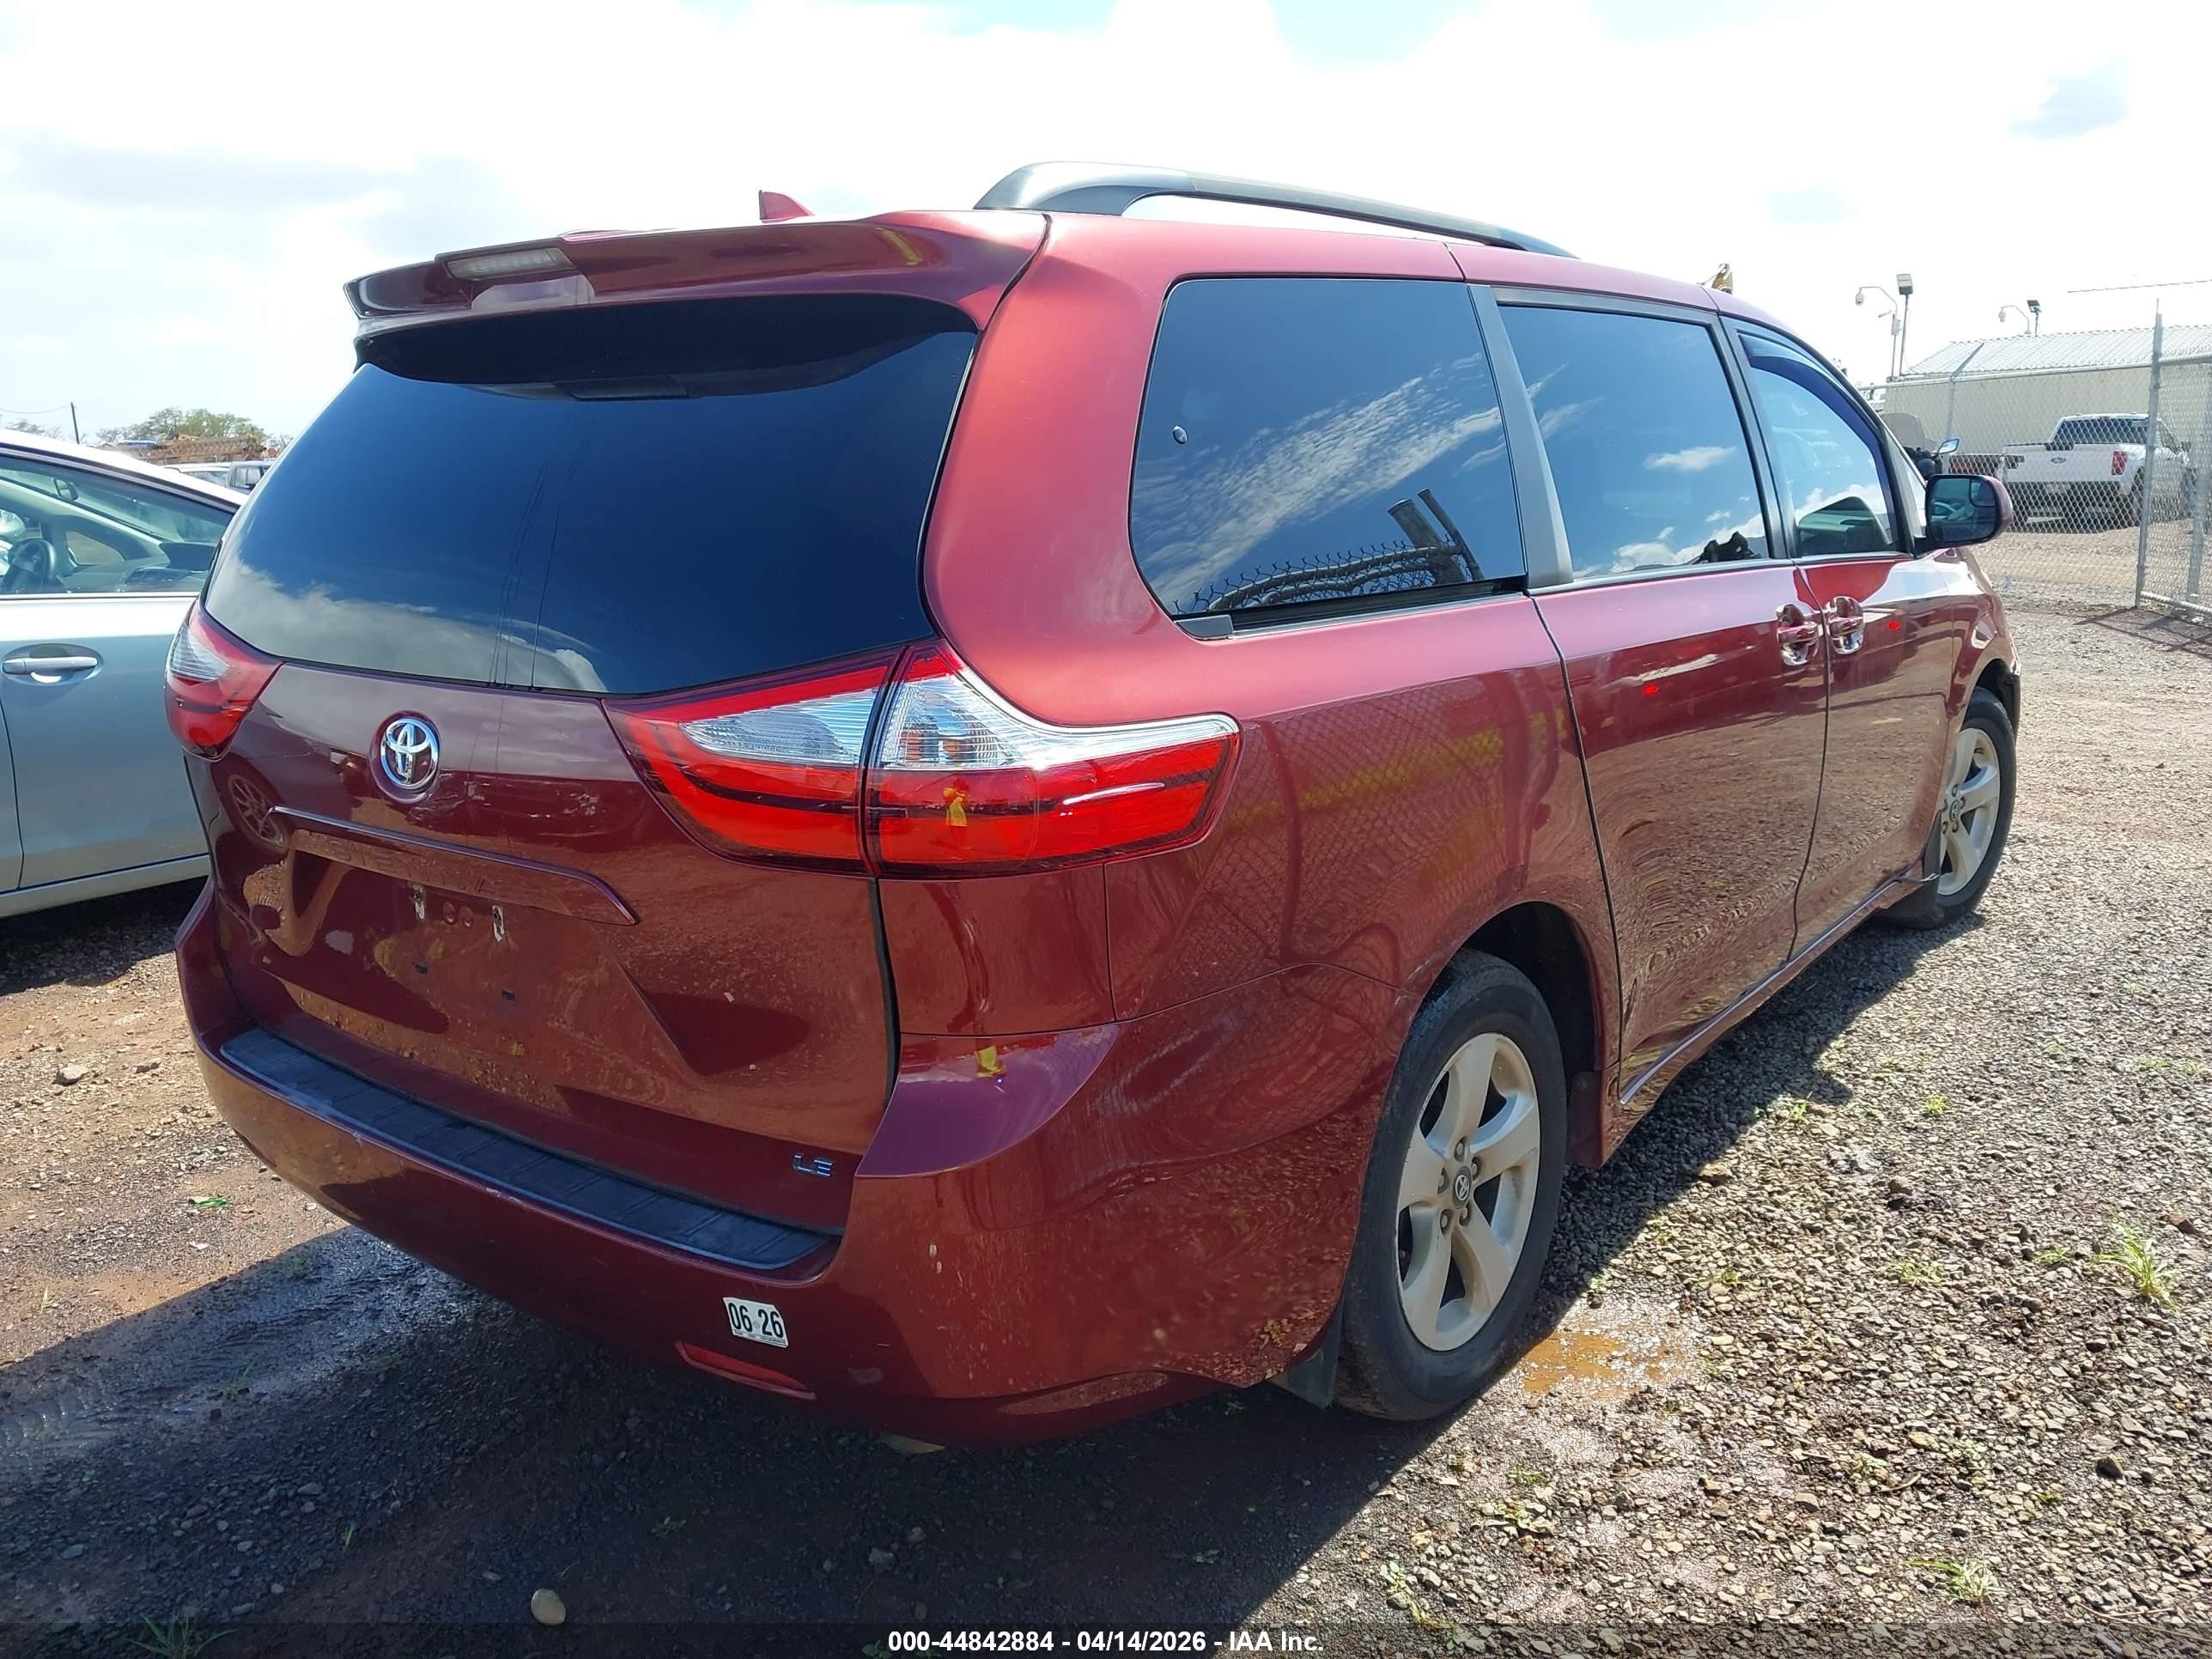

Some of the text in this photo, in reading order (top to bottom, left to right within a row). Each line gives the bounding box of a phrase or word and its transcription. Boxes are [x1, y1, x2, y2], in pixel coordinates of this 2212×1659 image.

[792, 1153, 833, 1177] LE
[728, 1302, 753, 1333] 06
[757, 1308, 784, 1339] 26
